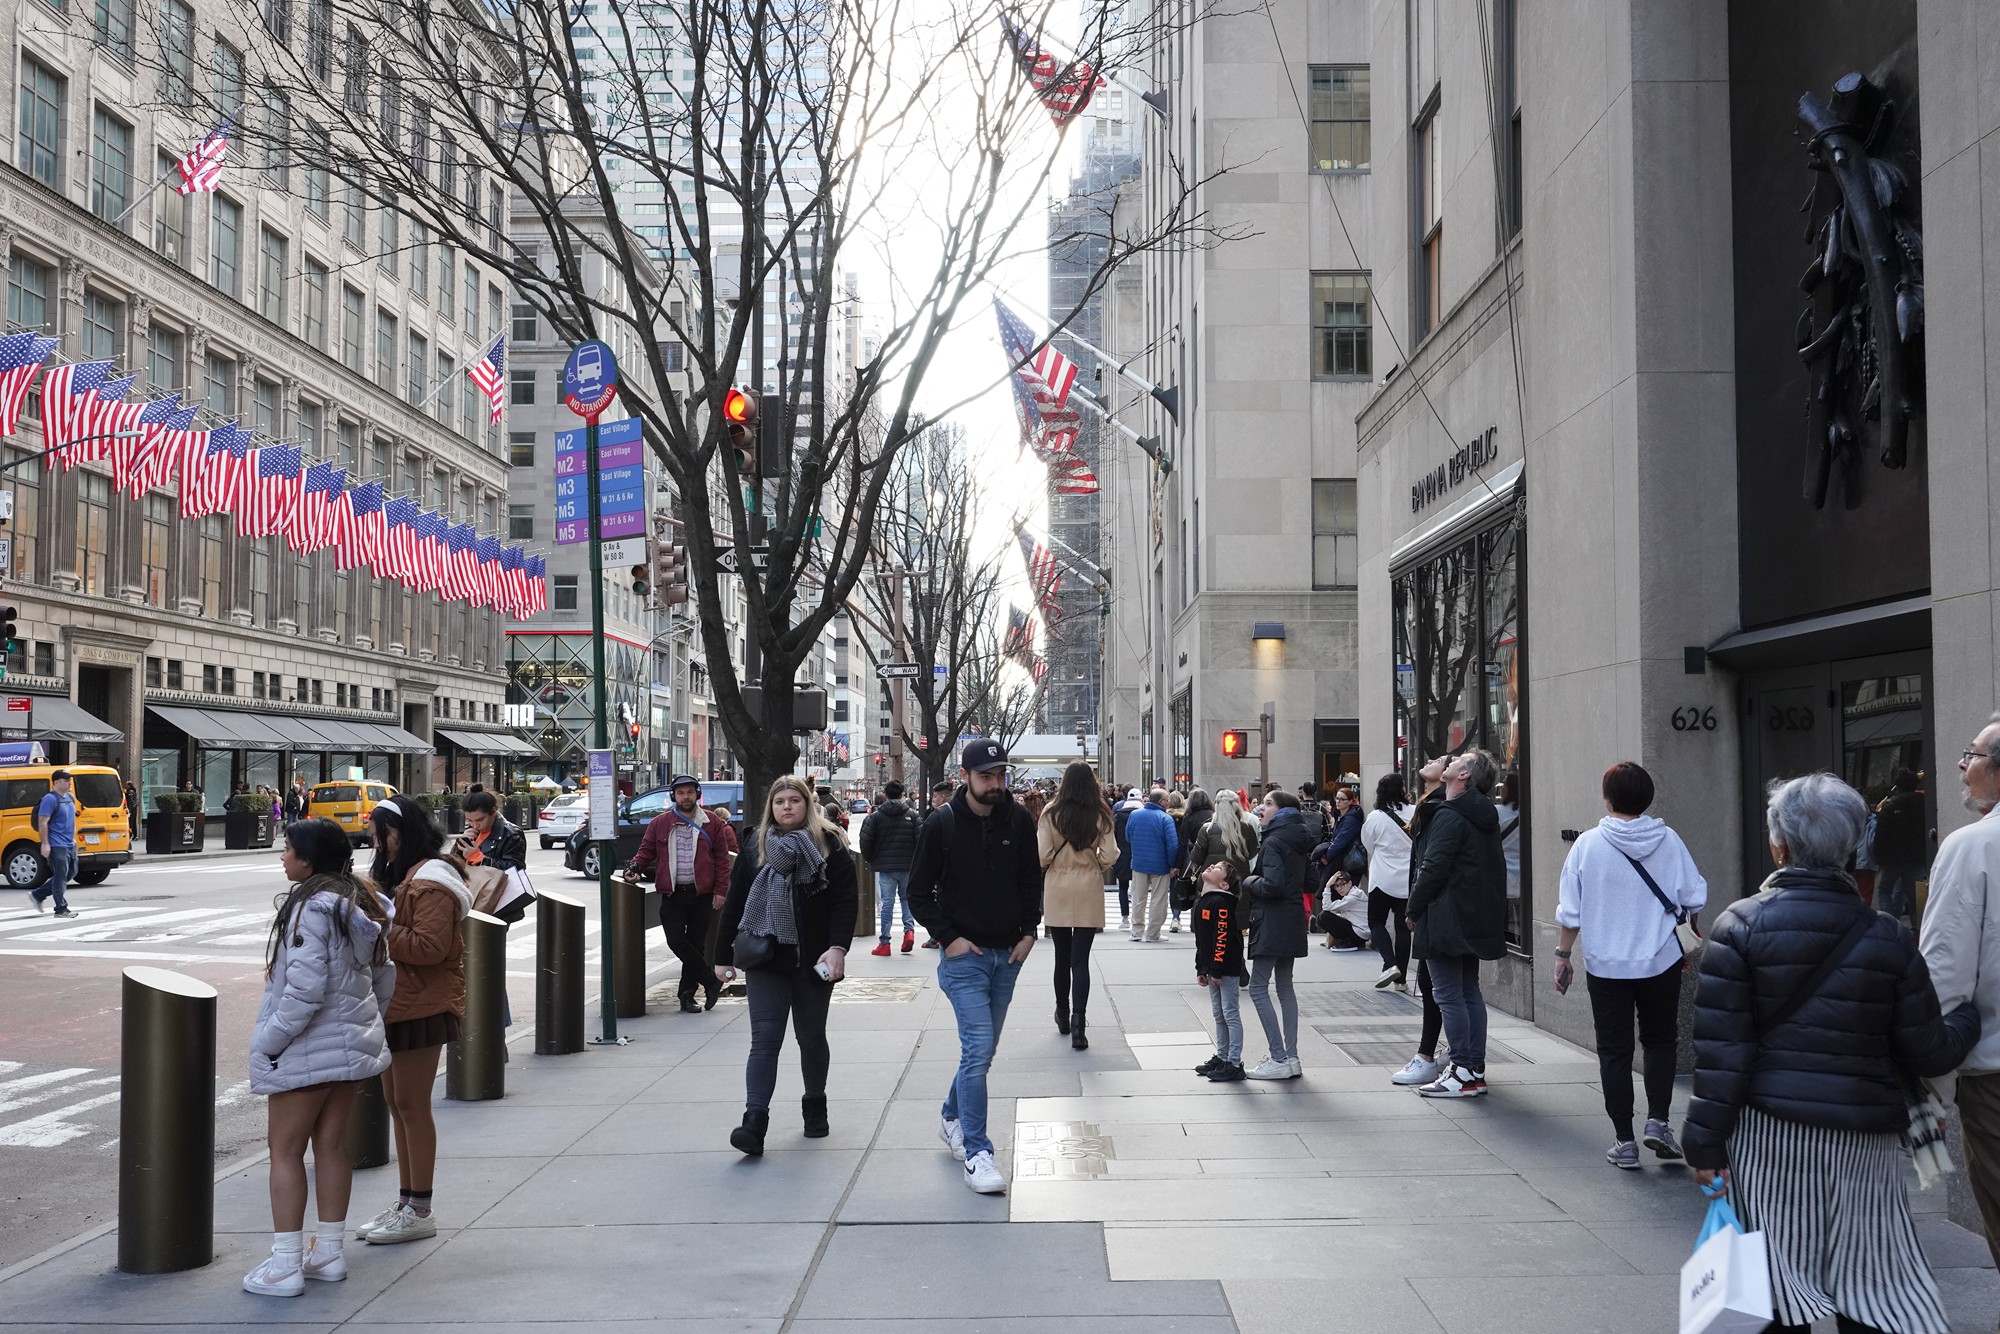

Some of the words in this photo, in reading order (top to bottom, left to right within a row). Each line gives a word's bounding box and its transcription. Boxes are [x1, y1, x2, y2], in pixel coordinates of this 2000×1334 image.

[570, 398, 580, 410] NO
[580, 387, 612, 412] STANDING
[600, 426, 612, 435] East
[612, 423, 630, 433] Village
[558, 434, 574, 452] M2
[601, 448, 612, 458] East
[613, 446, 630, 456] Village
[558, 456, 574, 474] M2
[1412, 463, 1447, 513] BANANA
[1449, 424, 1498, 489] REPUBLIC
[602, 471, 612, 480] East
[614, 470, 631, 479] Village
[558, 479, 574, 496] M3
[602, 496, 607, 504] W
[608, 494, 615, 502] 31
[559, 501, 575, 518] M5
[603, 518, 608, 526] W
[610, 517, 616, 525] 31
[559, 524, 575, 541] M5
[1671, 706, 1717, 731] 626
[1214, 908, 1228, 962] DENIM
